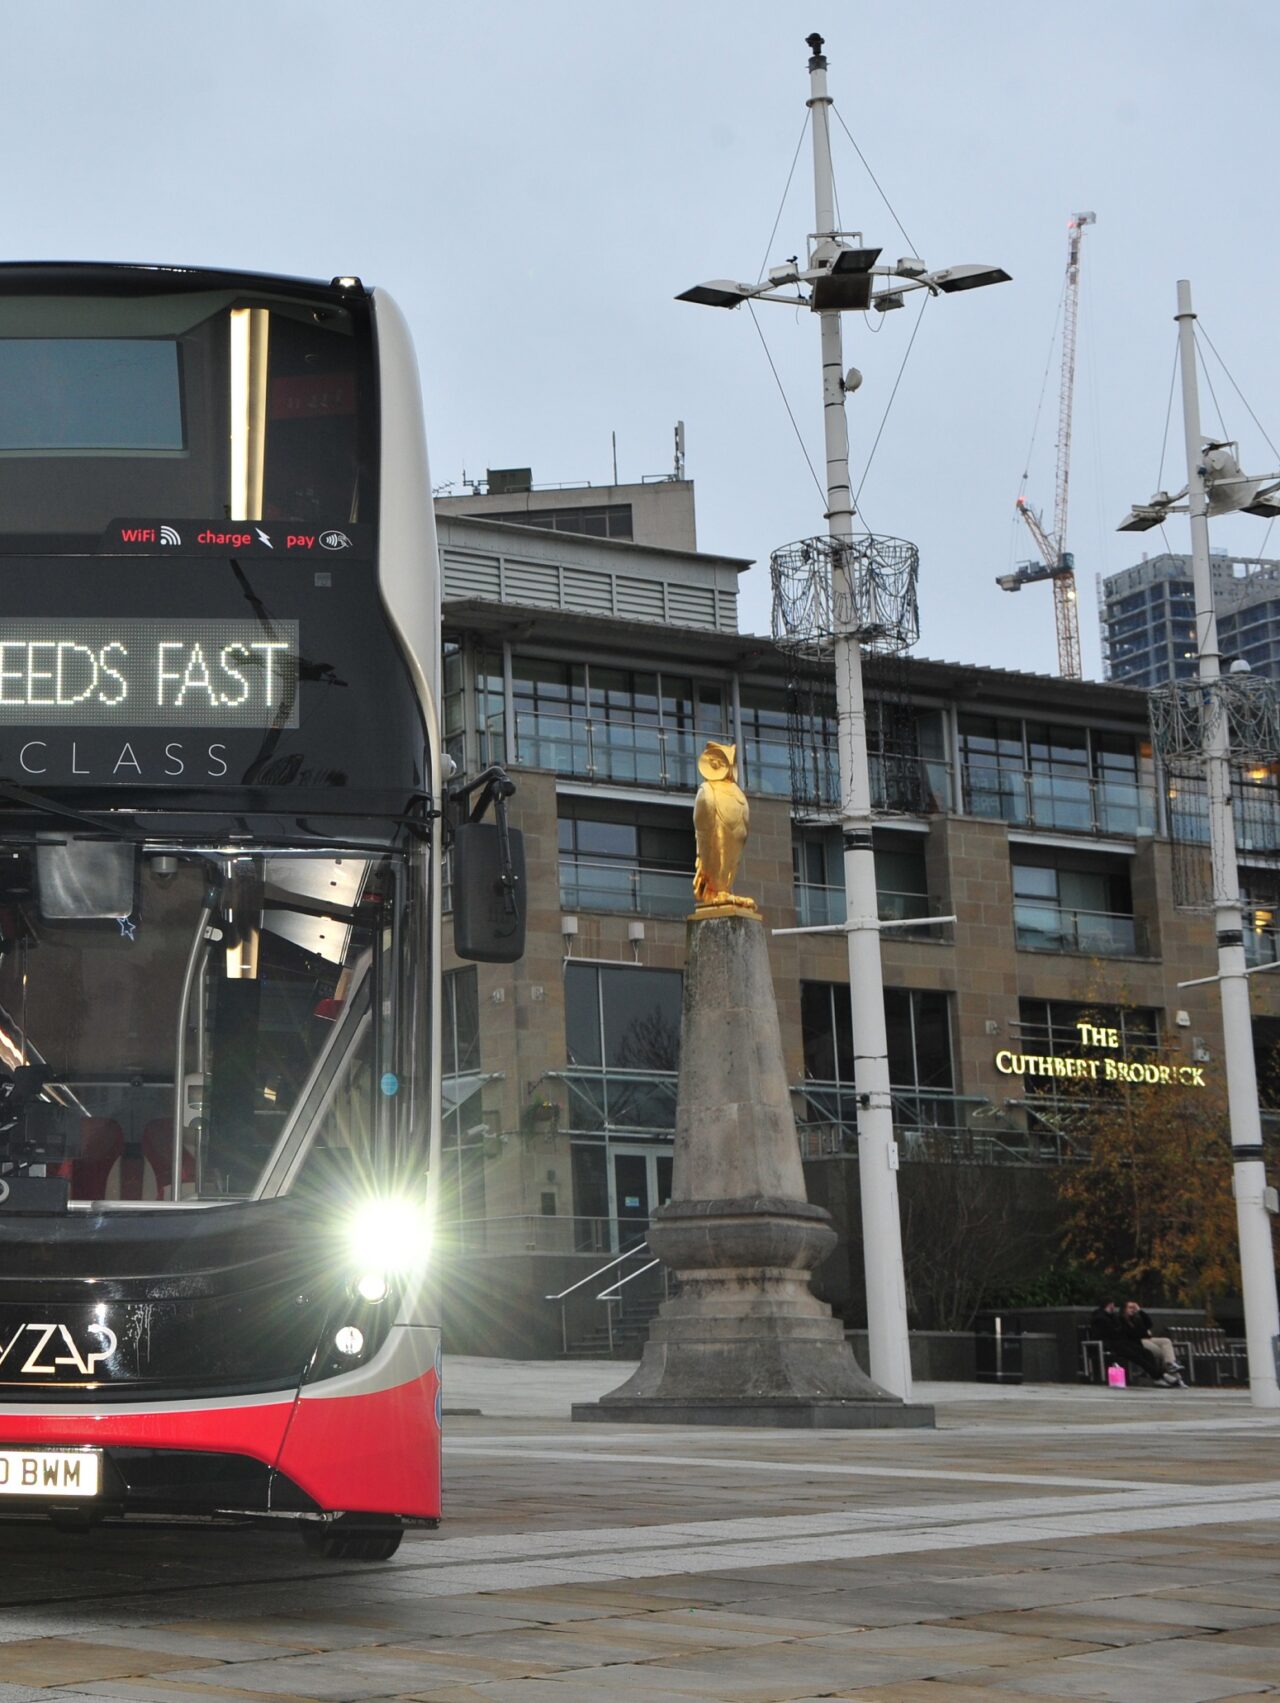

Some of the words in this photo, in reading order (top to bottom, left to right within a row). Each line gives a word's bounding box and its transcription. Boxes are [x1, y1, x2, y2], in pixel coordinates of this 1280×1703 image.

[121, 529, 156, 543] WiFi
[197, 530, 252, 547] charge
[287, 535, 315, 549] pay
[156, 642, 290, 706] FAST
[19, 741, 229, 776] CLASS
[1077, 1023, 1119, 1048] THE
[996, 1051, 1099, 1080] CUTHBERT
[1104, 1058, 1206, 1087] BRODRICK
[21, 1458, 81, 1487] BWM
